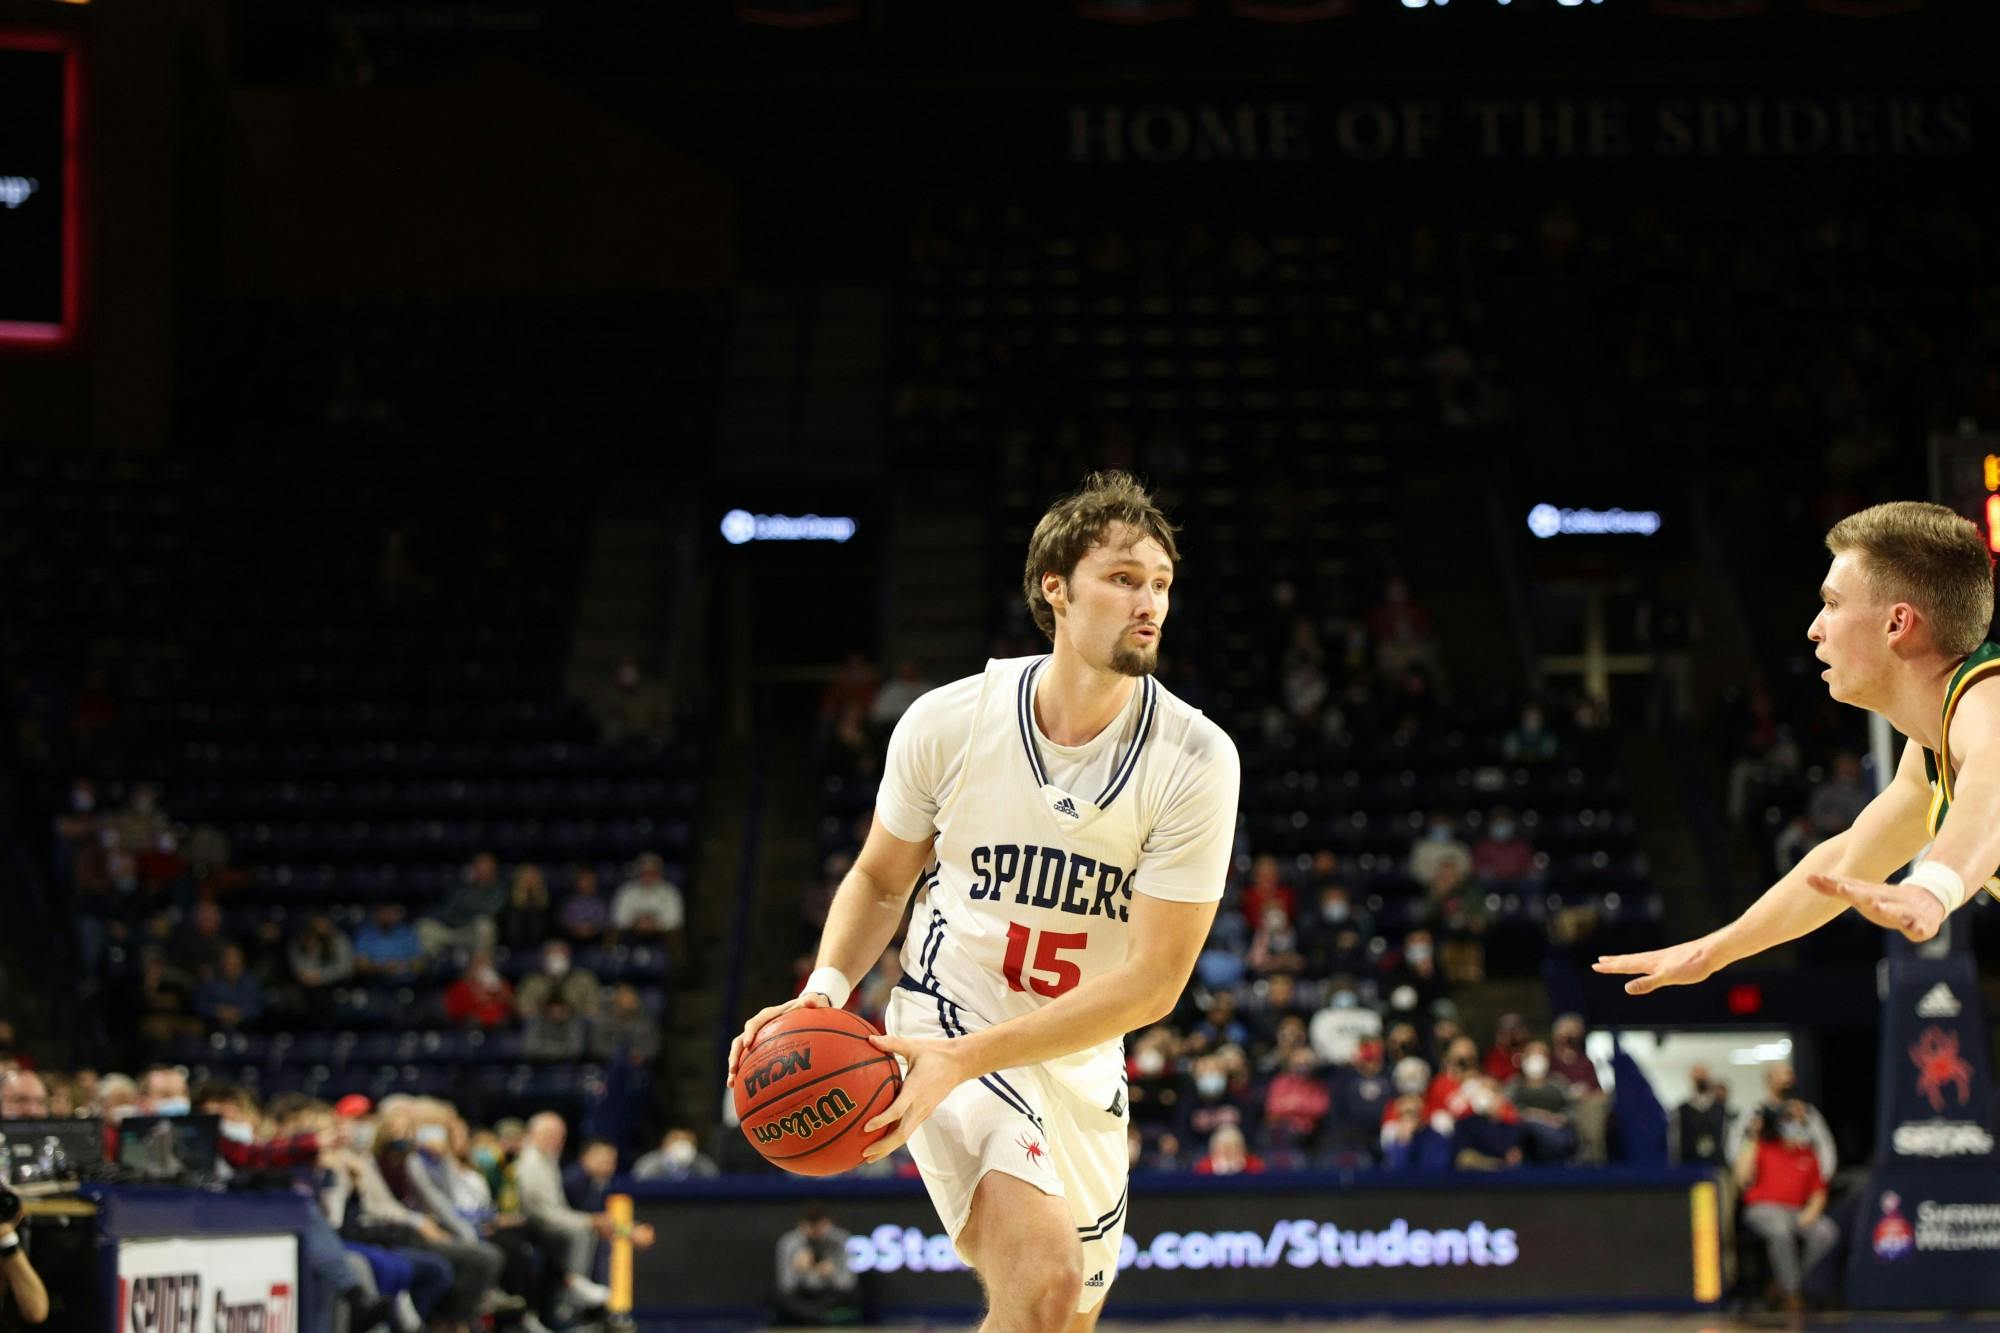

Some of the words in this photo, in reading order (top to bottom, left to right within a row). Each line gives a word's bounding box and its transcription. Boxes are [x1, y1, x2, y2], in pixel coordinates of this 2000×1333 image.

[1067, 102, 1312, 164] HOME
[1334, 98, 1442, 162] OF
[1465, 98, 1632, 161] THE
[1651, 96, 1976, 160] SPIDERS
[1053, 804, 1079, 819] adidas
[1002, 920, 1089, 999] 15
[744, 1047, 812, 1099] NCAA
[751, 1086, 858, 1144] Wilson
